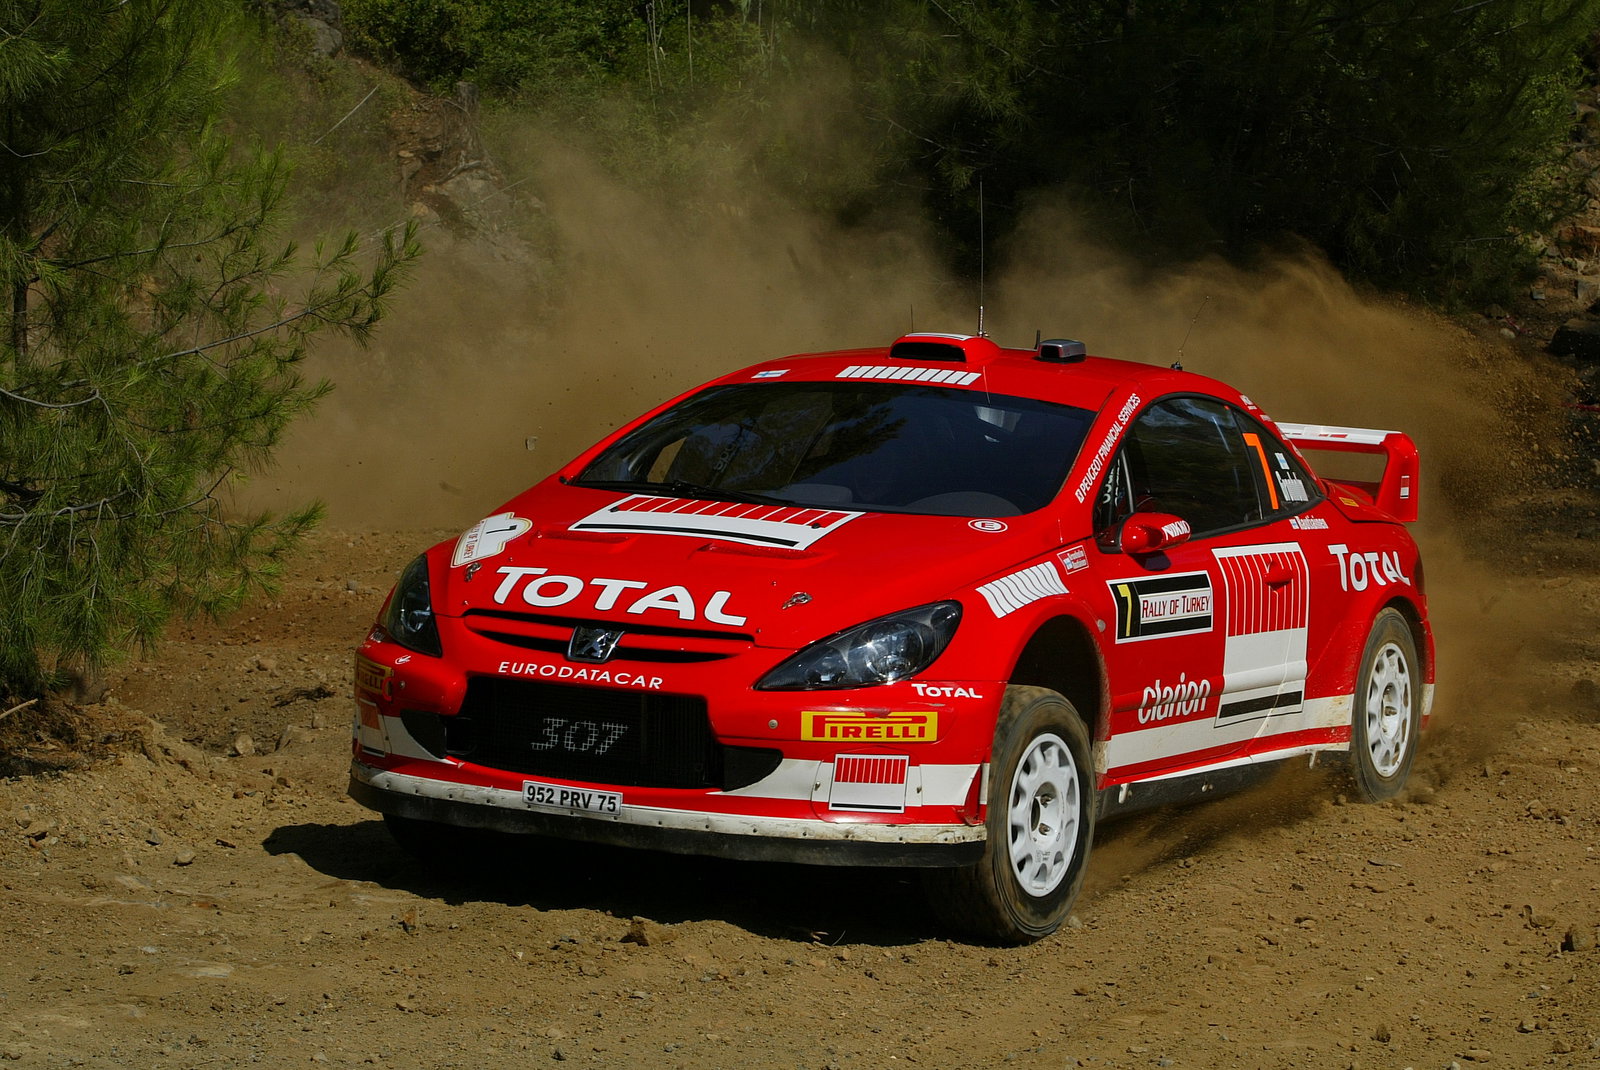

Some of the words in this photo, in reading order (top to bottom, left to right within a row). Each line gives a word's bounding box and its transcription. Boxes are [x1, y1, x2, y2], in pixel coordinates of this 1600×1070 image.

[1080, 454, 1104, 496] PEUGEOT
[1098, 421, 1123, 461] FINANCIAL
[1118, 393, 1141, 425] SERVICES
[1327, 544, 1411, 592] TOTAL
[494, 566, 747, 627] TOTAL
[1142, 600, 1168, 618] RALLY
[1169, 599, 1179, 615] OF
[1181, 595, 1210, 613] TURKEY
[498, 661, 663, 690] EURODATACAR
[911, 683, 983, 699] TOTAL
[1138, 672, 1211, 724] clarion
[531, 717, 629, 755] 307
[812, 715, 928, 738] PIRELLI
[527, 785, 555, 804] 952
[560, 789, 592, 809] PRV
[597, 794, 617, 812] 75
